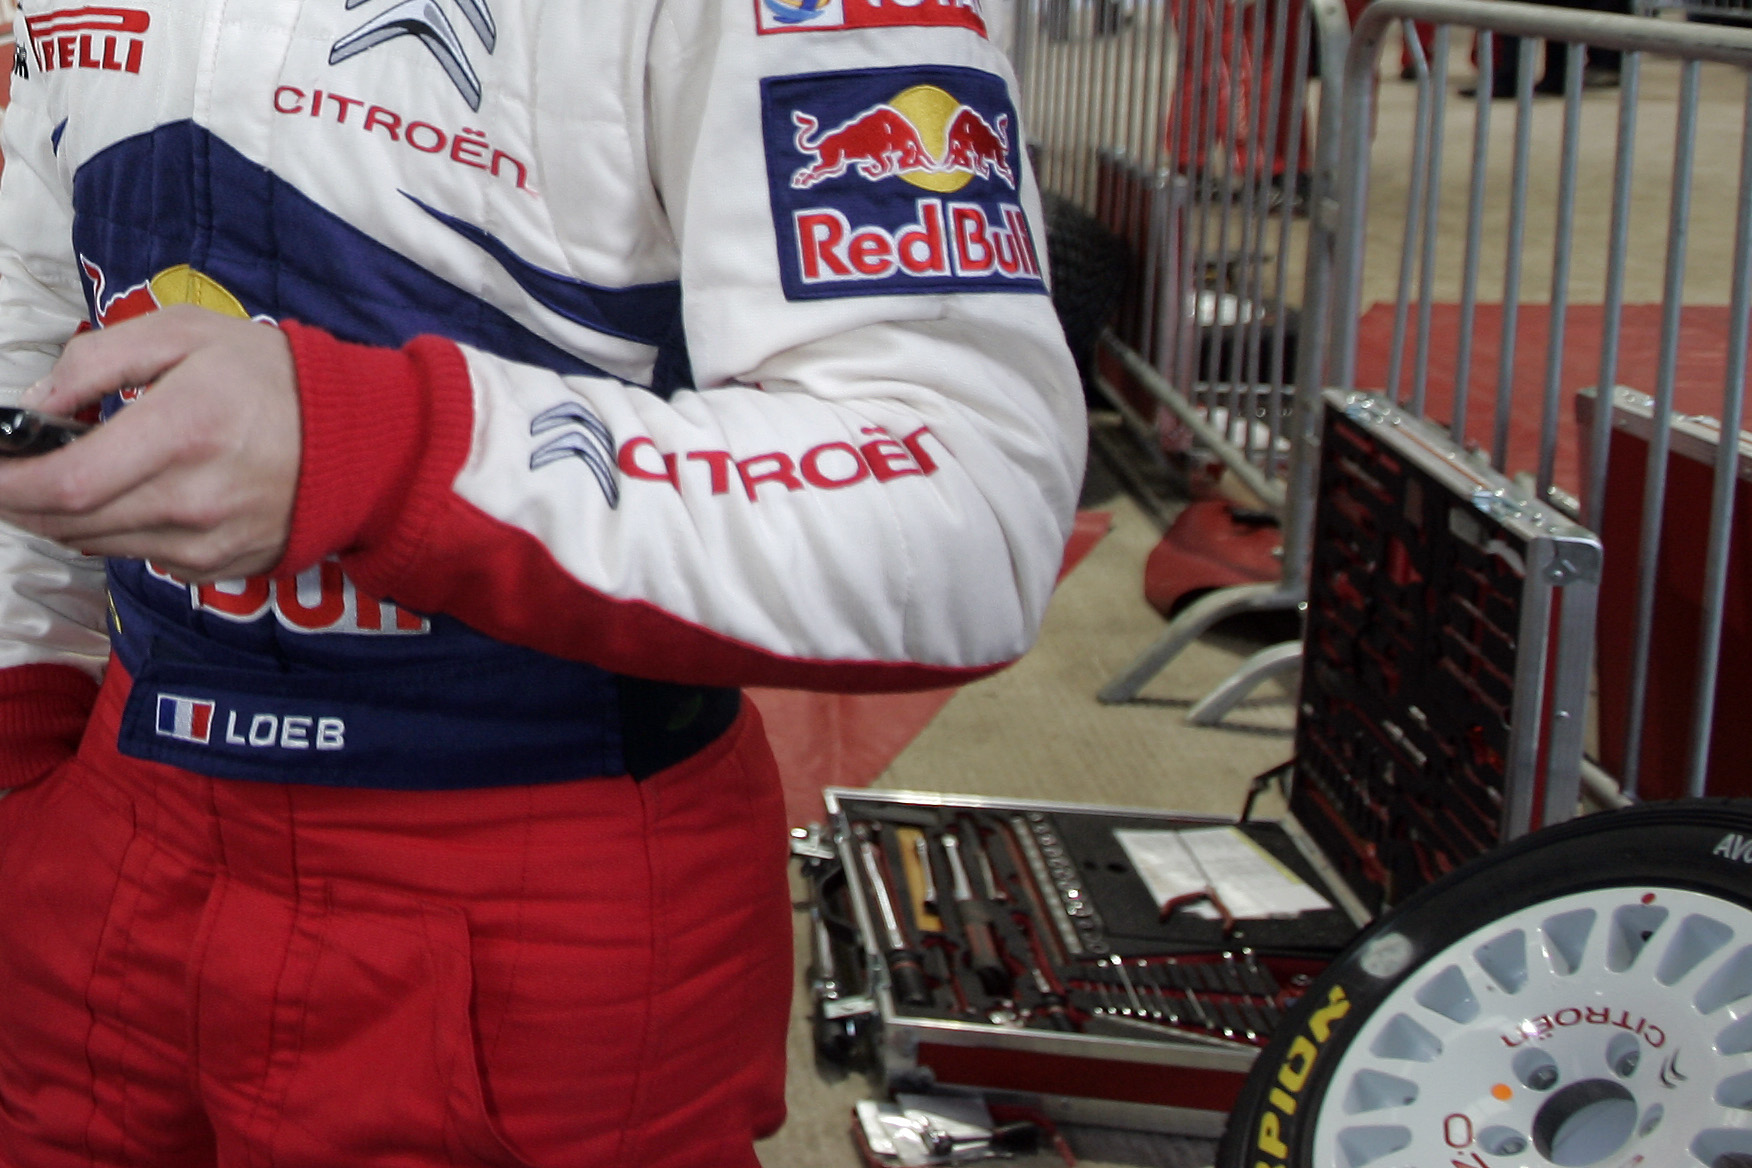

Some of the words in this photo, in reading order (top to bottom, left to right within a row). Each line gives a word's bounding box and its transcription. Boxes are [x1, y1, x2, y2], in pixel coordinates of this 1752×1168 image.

[274, 86, 533, 190] CITROËN
[792, 198, 952, 284] Red
[947, 201, 1043, 279] Bull
[225, 709, 346, 751] LOEB
